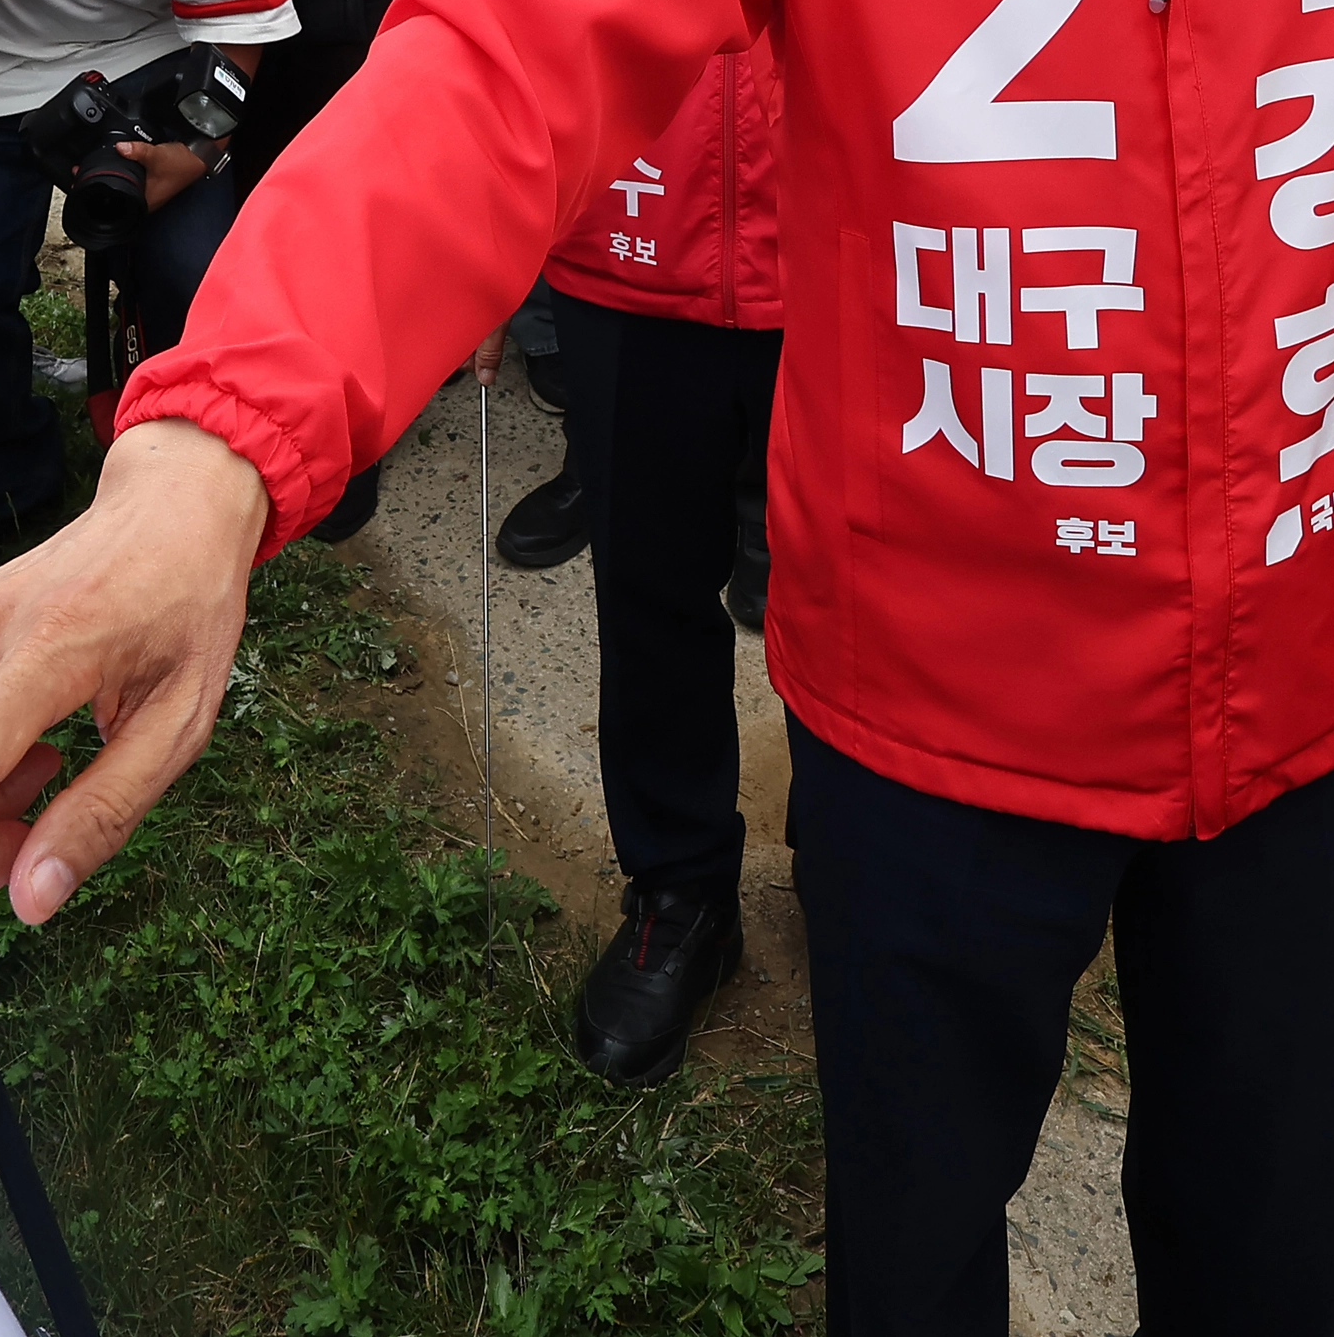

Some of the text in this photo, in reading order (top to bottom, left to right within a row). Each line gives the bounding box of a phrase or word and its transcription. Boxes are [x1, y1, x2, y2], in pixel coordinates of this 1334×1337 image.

[608, 231, 658, 266] 후보
[892, 221, 1146, 351] 대구
[127, 324, 139, 365] EOS
[901, 358, 1158, 489] 시장
[1055, 517, 1138, 557] 후보
